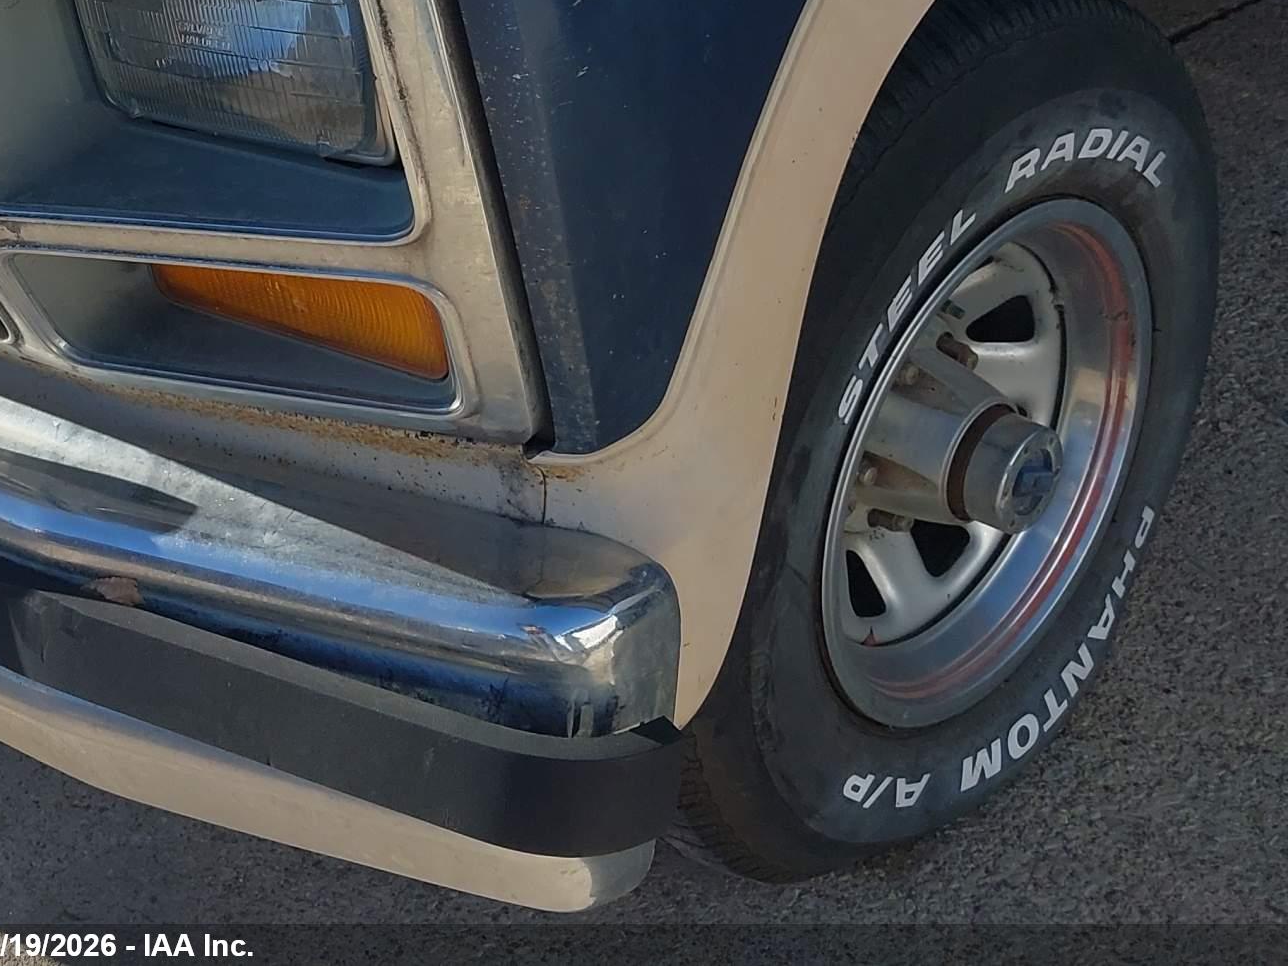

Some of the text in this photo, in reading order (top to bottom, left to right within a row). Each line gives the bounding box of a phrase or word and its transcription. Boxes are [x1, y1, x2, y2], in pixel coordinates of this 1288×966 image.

[836, 127, 1167, 426] STEEL RADIAL
[842, 505, 1155, 810] PHANTOM A/P
